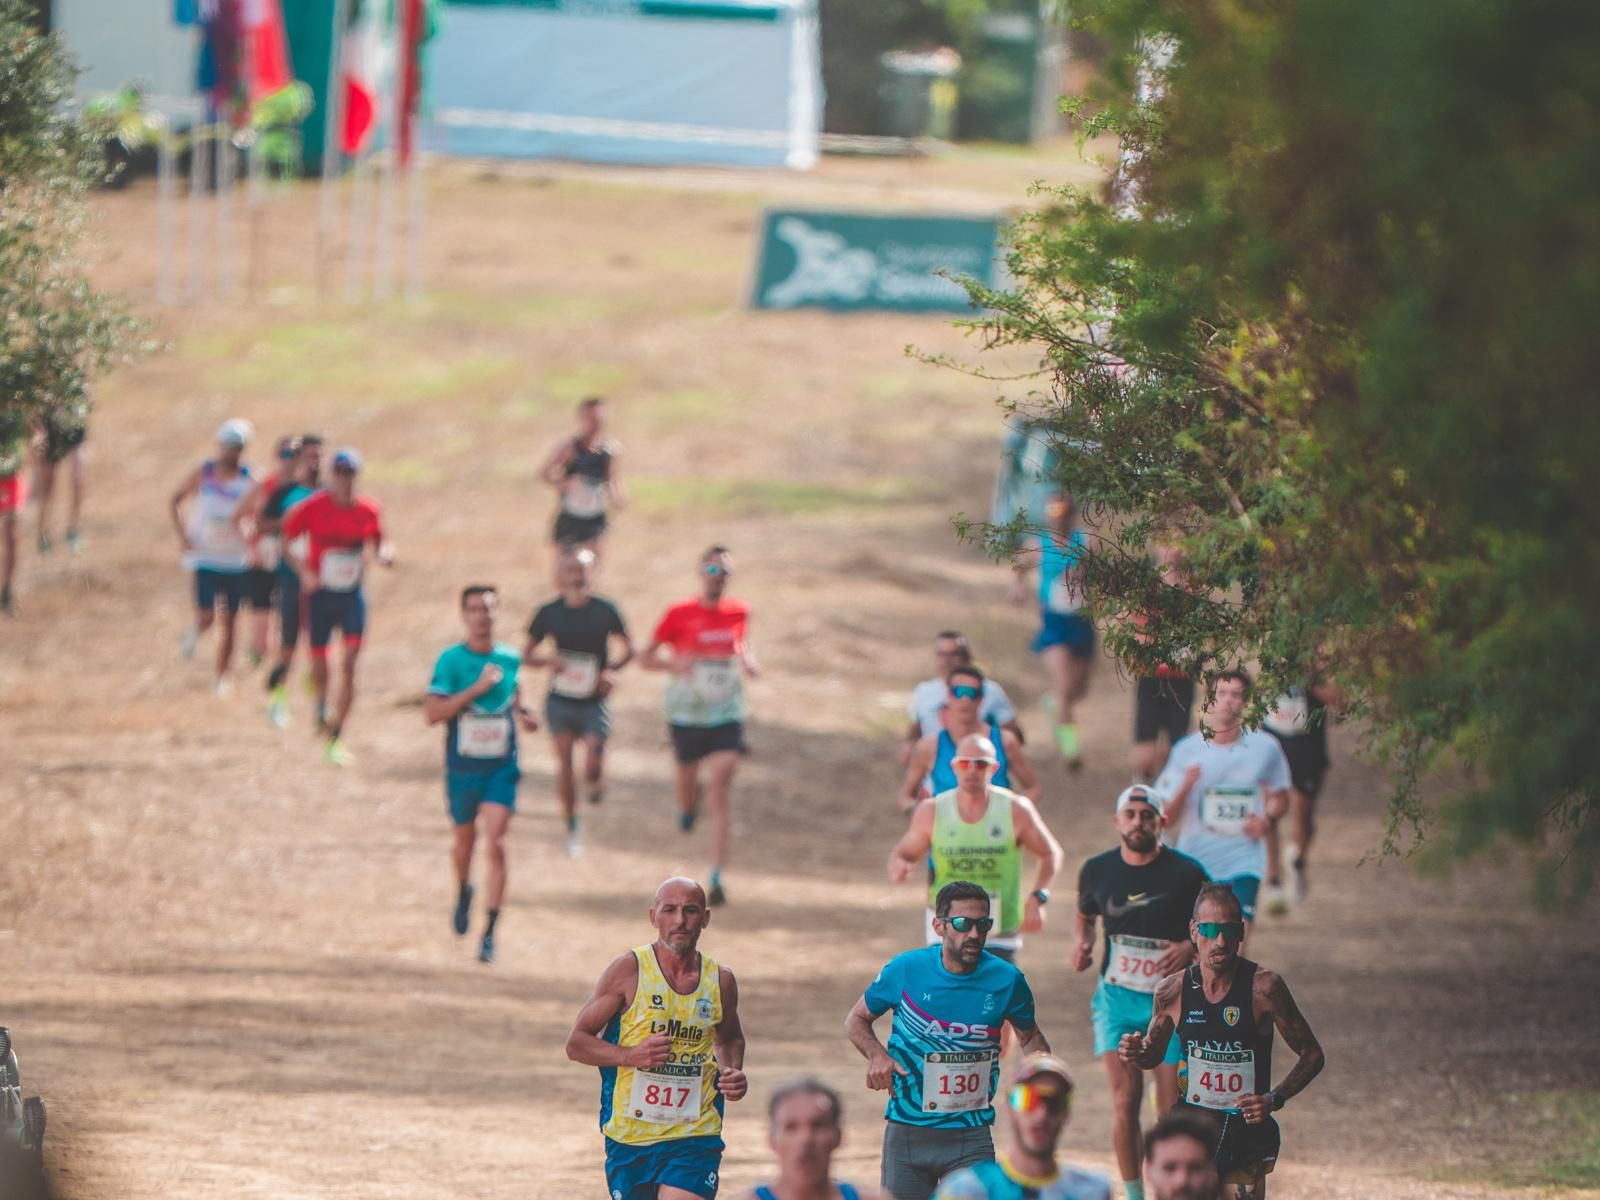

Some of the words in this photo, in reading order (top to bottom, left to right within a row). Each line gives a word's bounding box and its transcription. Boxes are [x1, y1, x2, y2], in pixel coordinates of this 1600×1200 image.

[1119, 957, 1154, 977] 370
[924, 1020, 989, 1039] ADS
[1187, 1040, 1242, 1052] PLAYAS
[938, 1073, 980, 1095] 130
[1199, 1071, 1243, 1092] 410
[645, 1084, 690, 1108] 817
